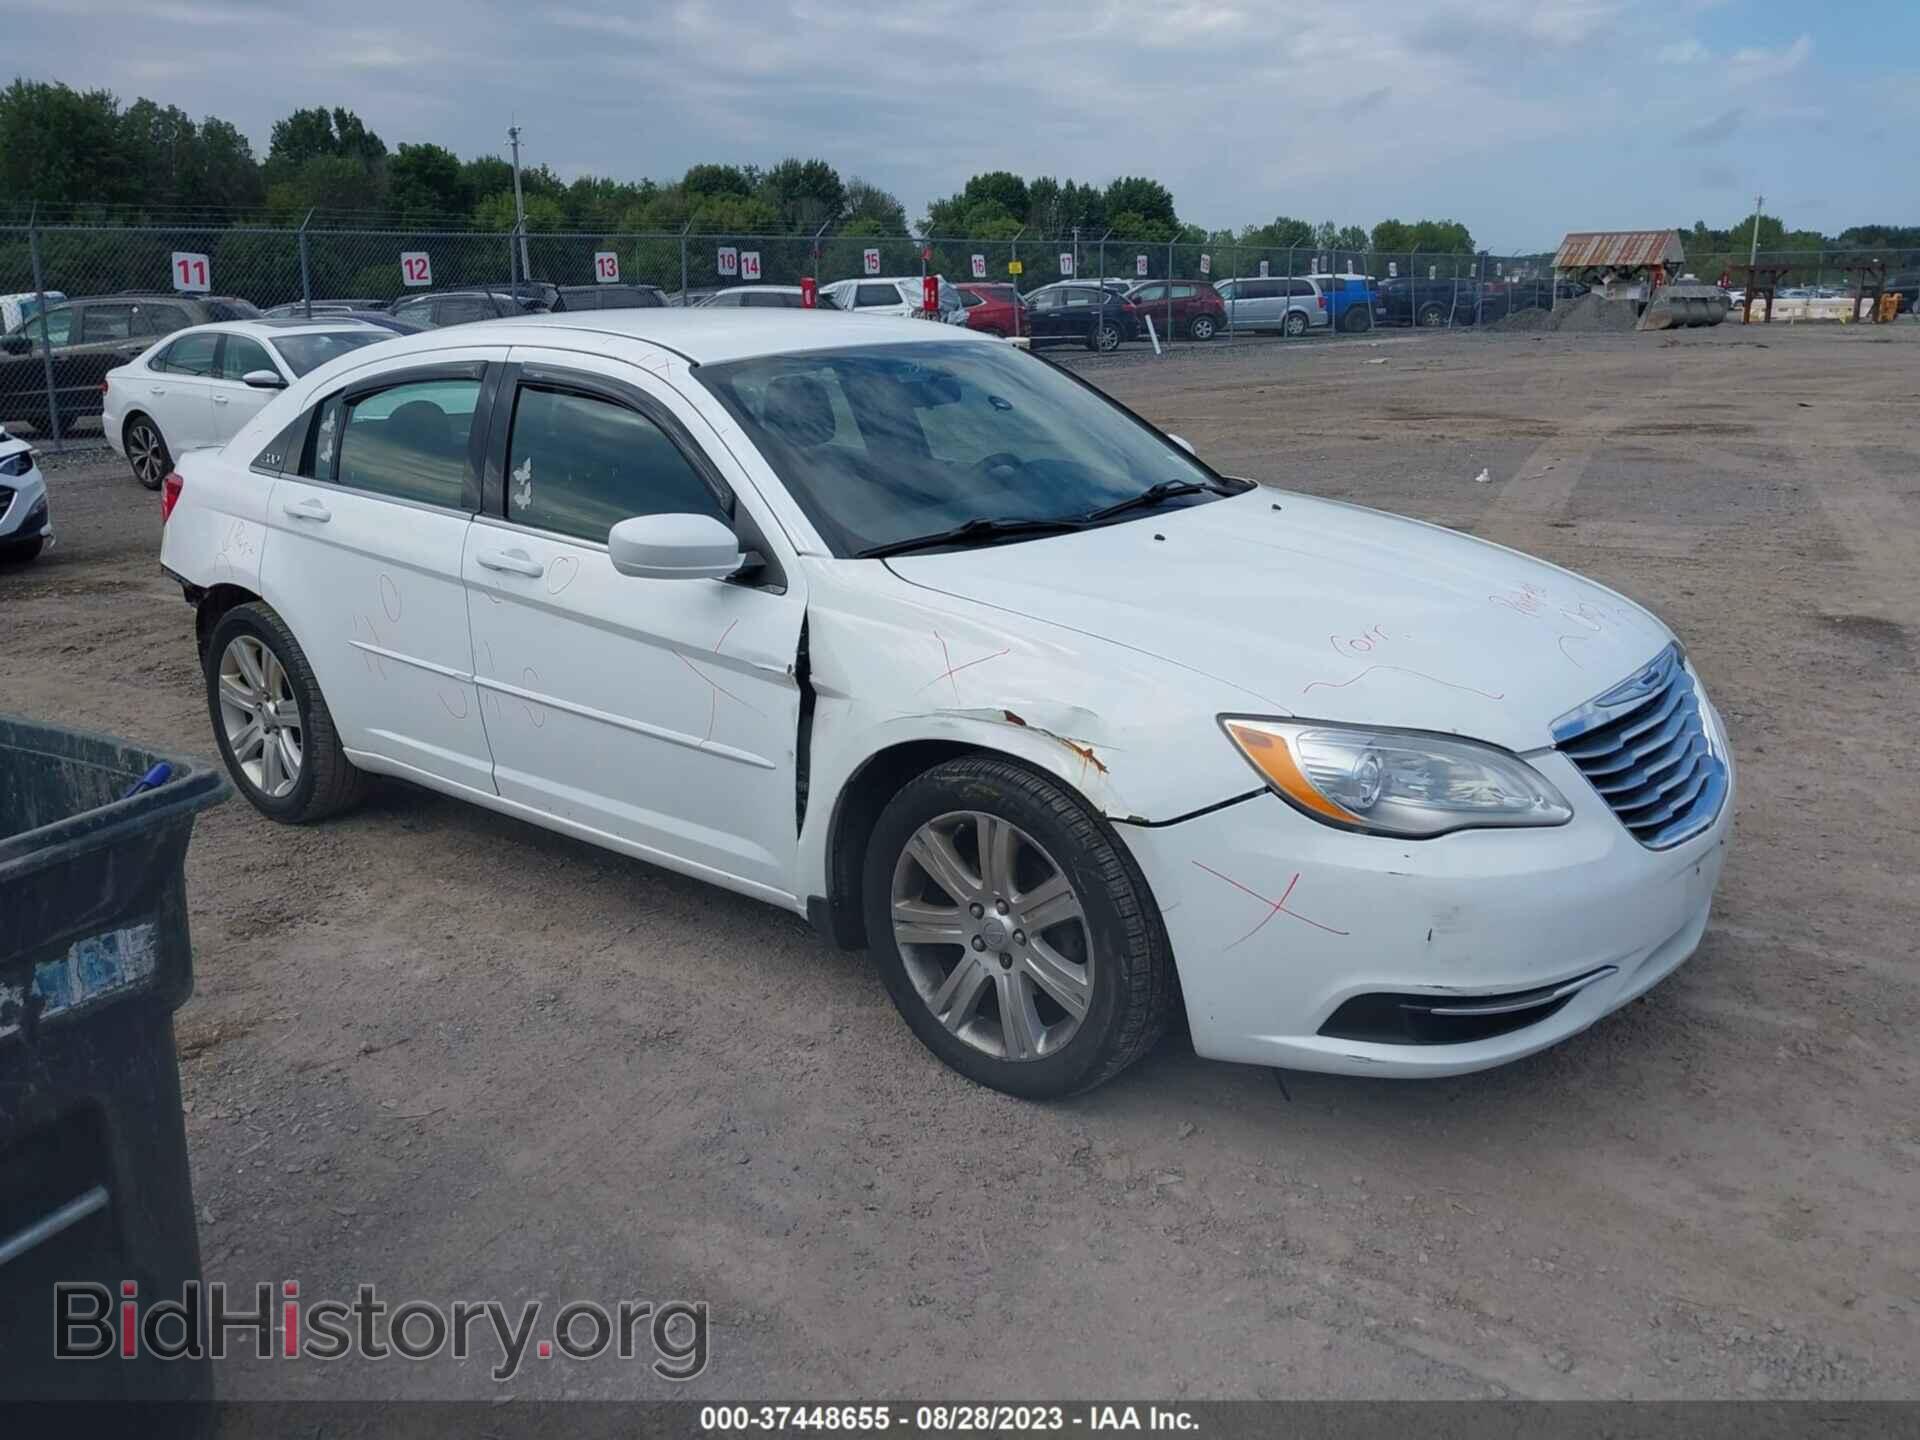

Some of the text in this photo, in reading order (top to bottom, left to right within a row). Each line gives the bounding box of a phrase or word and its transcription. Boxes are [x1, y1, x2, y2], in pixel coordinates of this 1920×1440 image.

[404, 258, 429, 281] 12
[598, 257, 617, 278] 13
[719, 254, 736, 270] 10
[742, 256, 760, 275] 14
[865, 253, 879, 270] 15
[177, 259, 206, 286] 11
